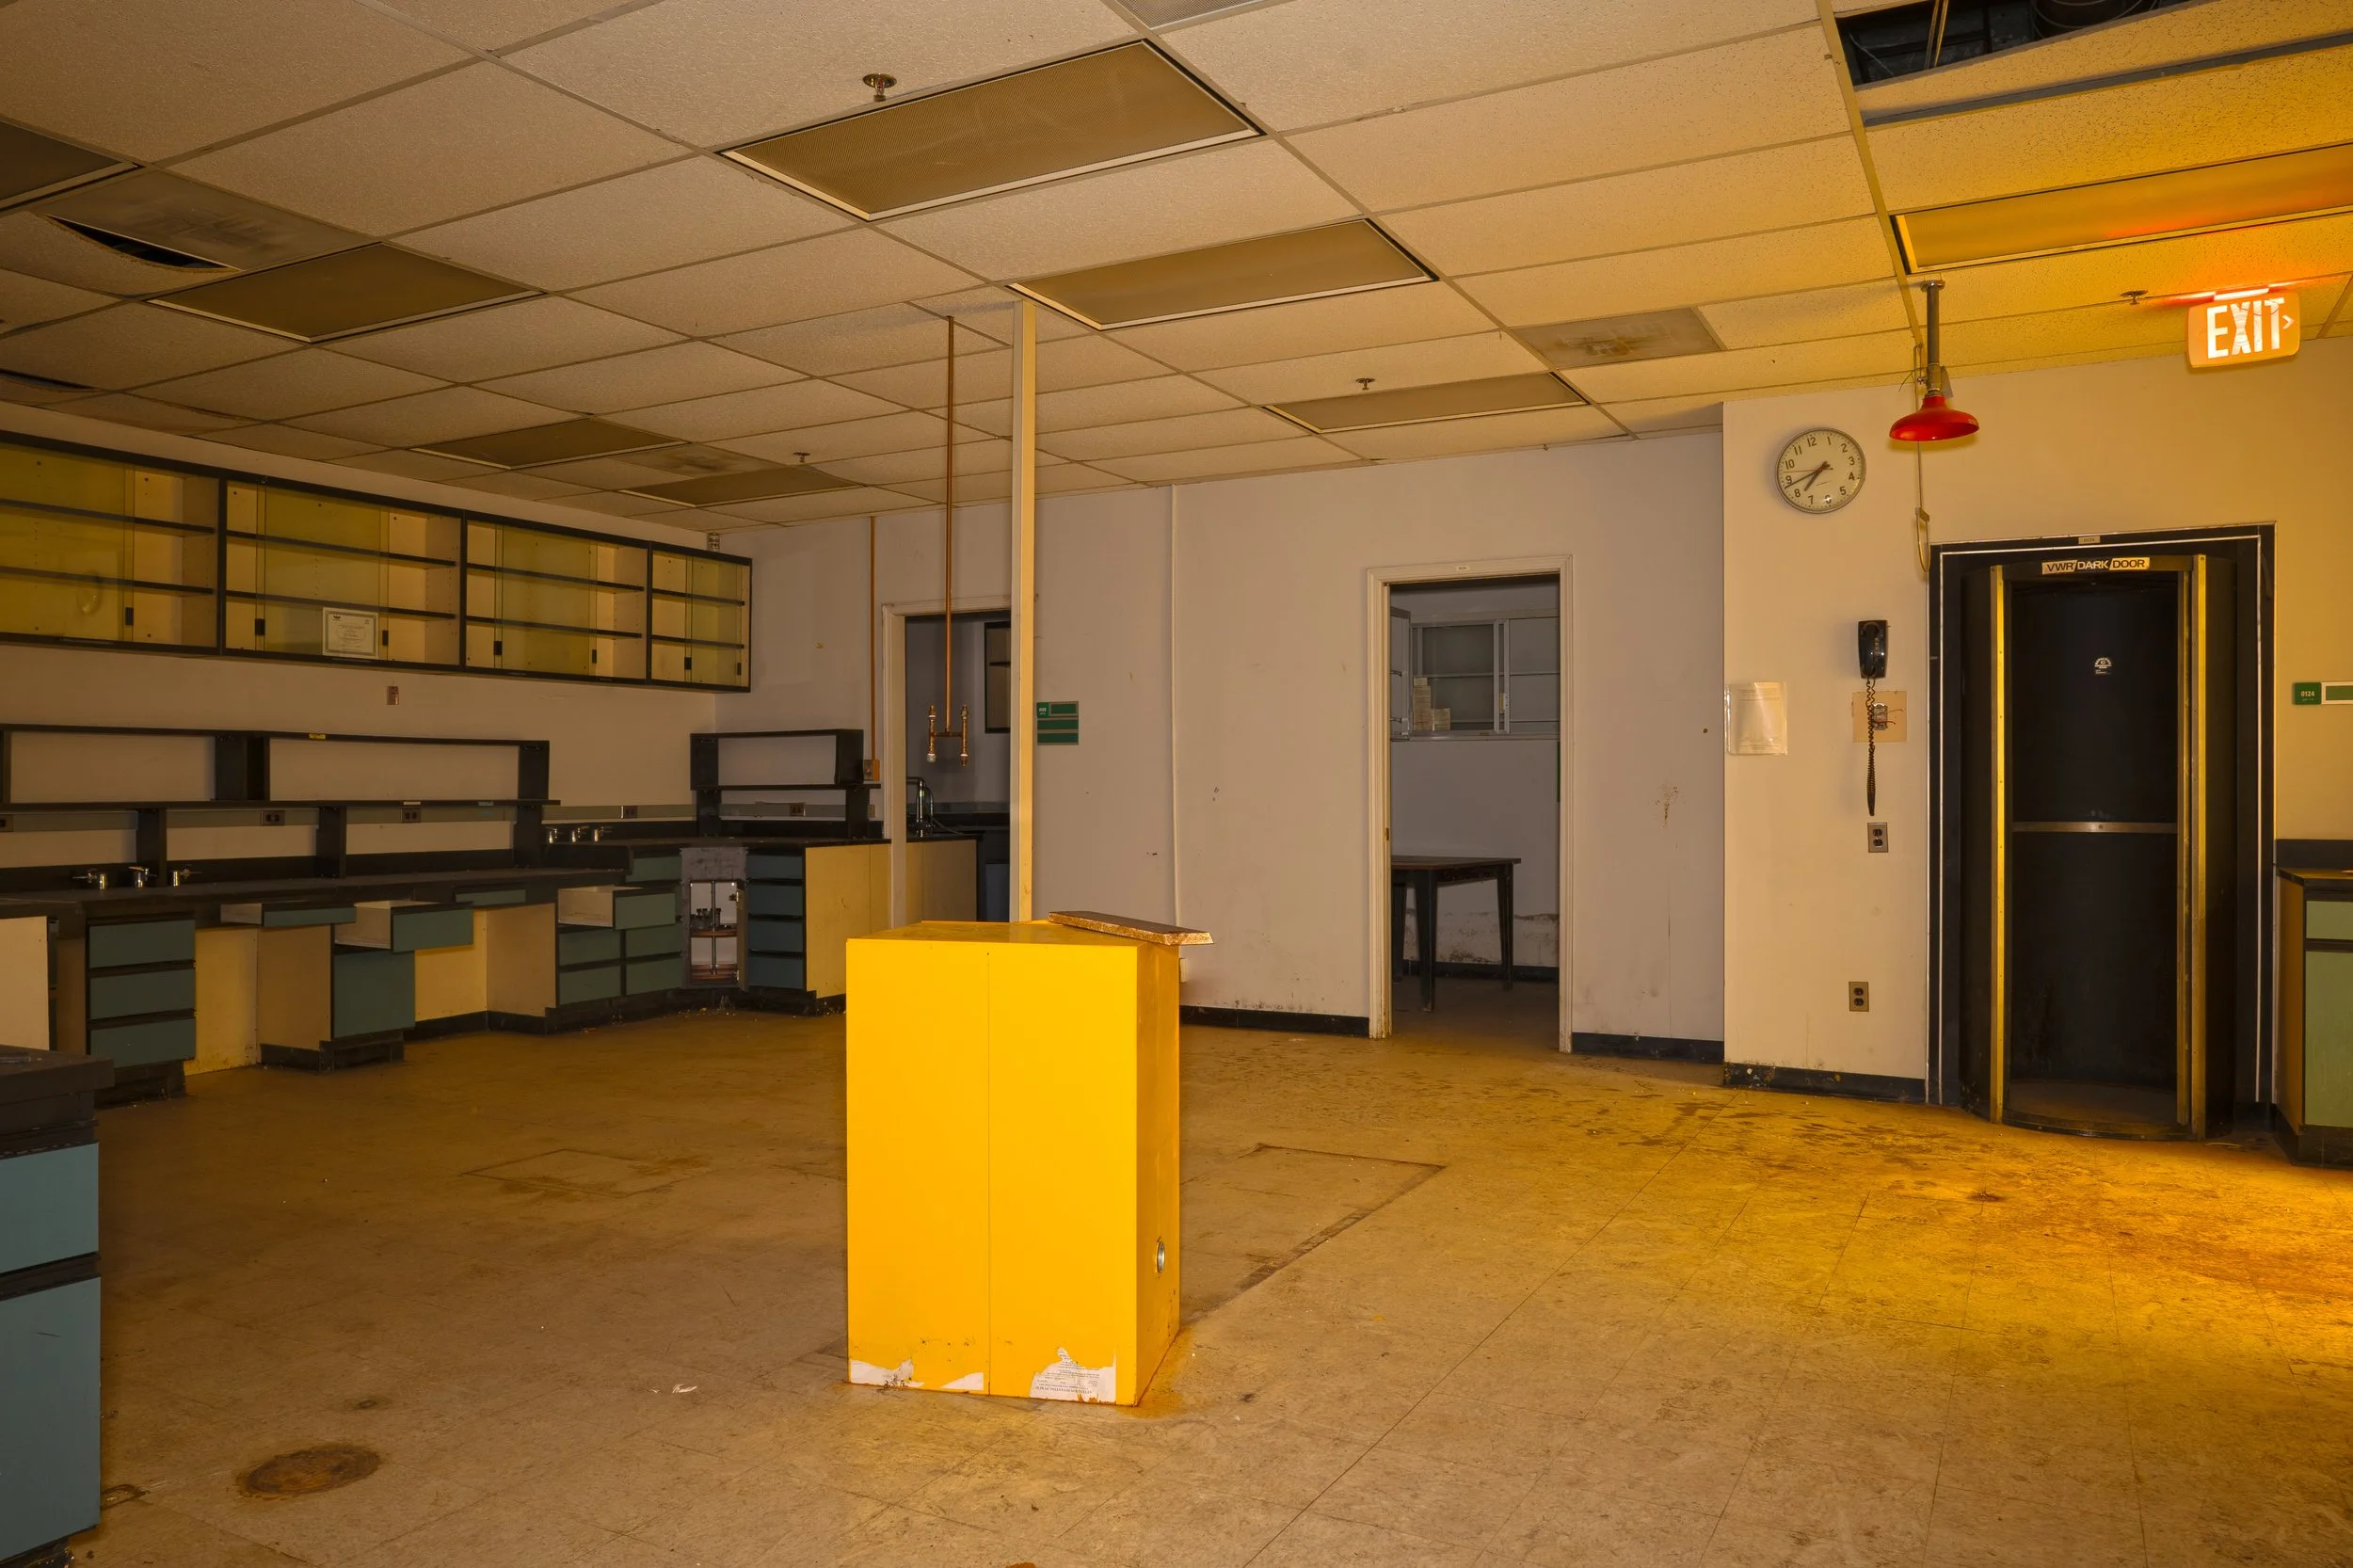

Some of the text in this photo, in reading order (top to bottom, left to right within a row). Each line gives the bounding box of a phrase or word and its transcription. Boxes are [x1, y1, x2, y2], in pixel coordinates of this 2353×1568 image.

[2207, 297, 2285, 360] EXIT
[1807, 437, 1817, 447] 12
[1827, 436, 1832, 445] 1
[1793, 445, 1802, 456] 11
[1841, 443, 1848, 453] 2
[1785, 458, 1795, 470] 10
[1849, 456, 1854, 465] 3
[1785, 474, 1793, 485] 9
[1849, 472, 1854, 481] 4
[1794, 488, 1801, 498] 8
[1839, 486, 1847, 495] 5
[1807, 495, 1814, 505] 7
[2047, 559, 2145, 571] VWR DARK DOOR
